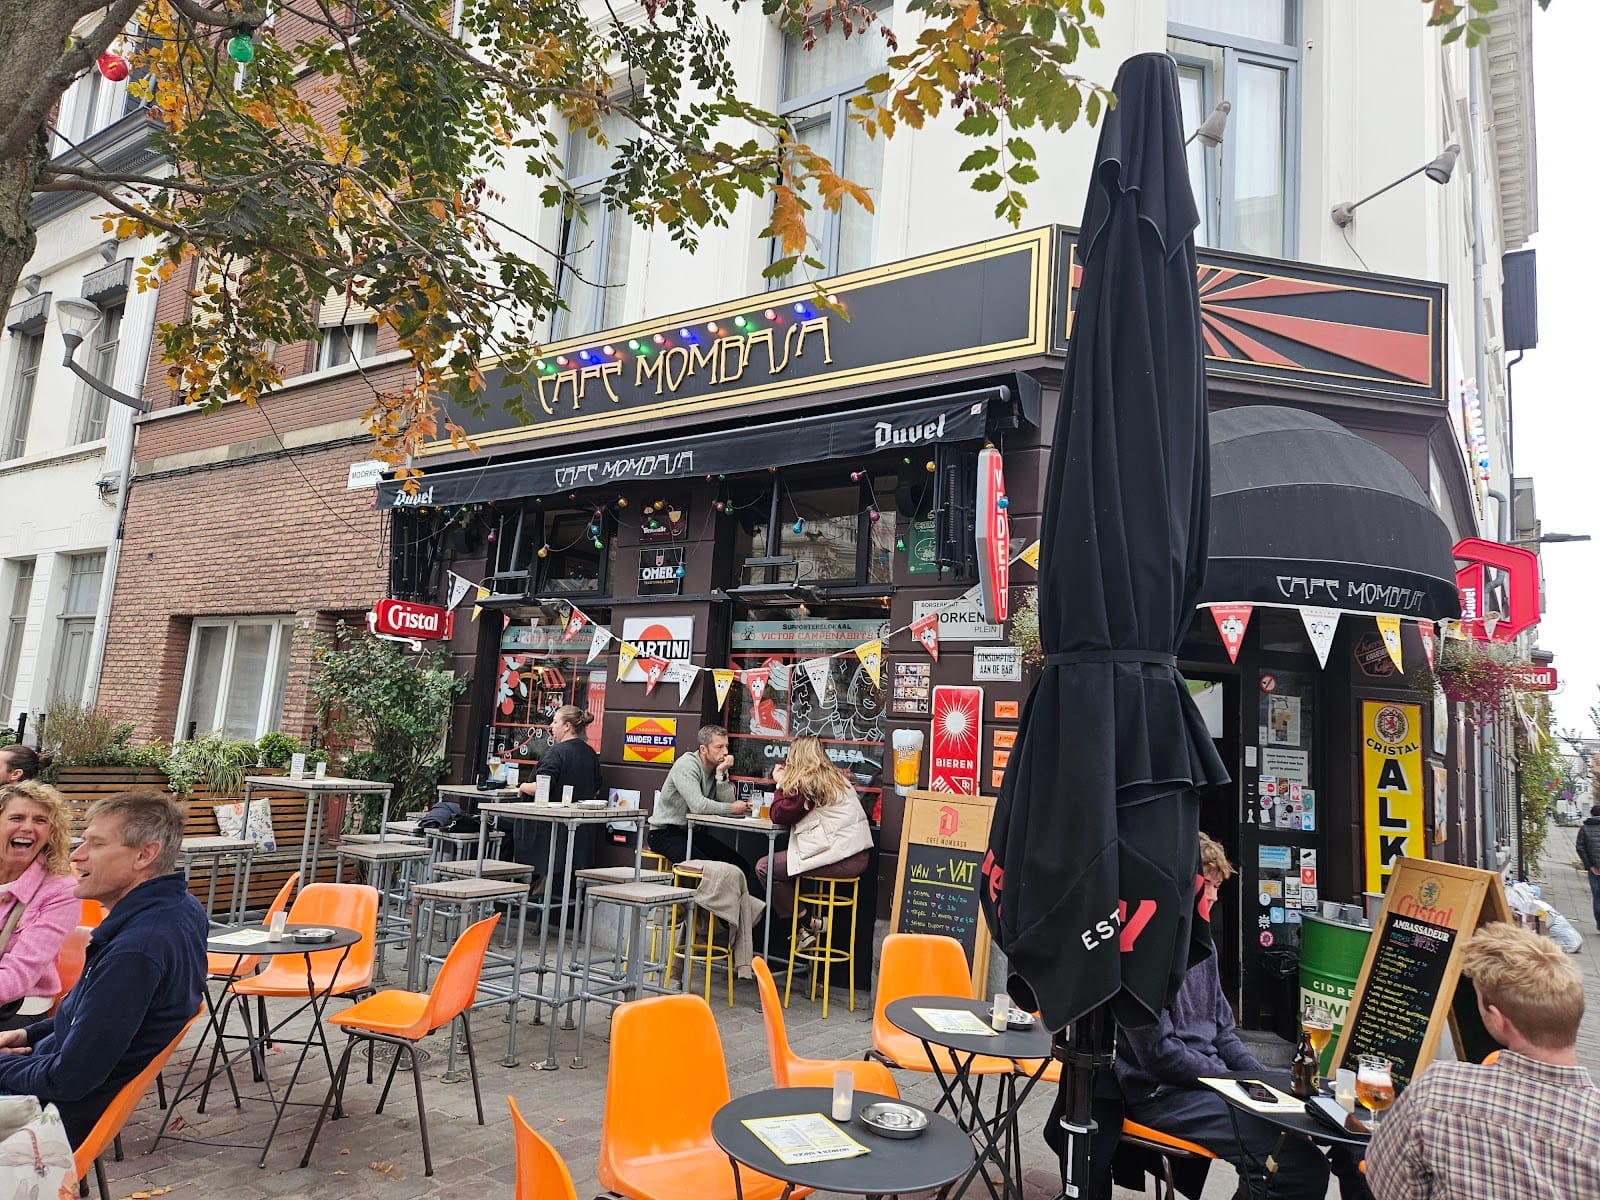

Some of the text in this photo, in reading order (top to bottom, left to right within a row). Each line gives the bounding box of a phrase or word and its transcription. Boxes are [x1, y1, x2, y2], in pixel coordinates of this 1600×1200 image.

[634, 316, 833, 395] MOMBASA
[874, 413, 946, 448] Duvel
[601, 450, 694, 479] MOMBASA
[393, 485, 434, 506] Duvel
[387, 604, 439, 632] Cristal
[760, 632, 794, 640] VICTOR
[992, 664, 1000, 674] DE
[626, 734, 674, 745] VANDER ELST
[1366, 737, 1420, 756] CRISTAL
[763, 744, 790, 758] CAF
[935, 757, 974, 769] BIEREN
[911, 863, 930, 879] VAN
[949, 858, 978, 884] VAT
[1392, 919, 1450, 943] AMBASSADEUR
[1312, 980, 1356, 998] CIDRE
